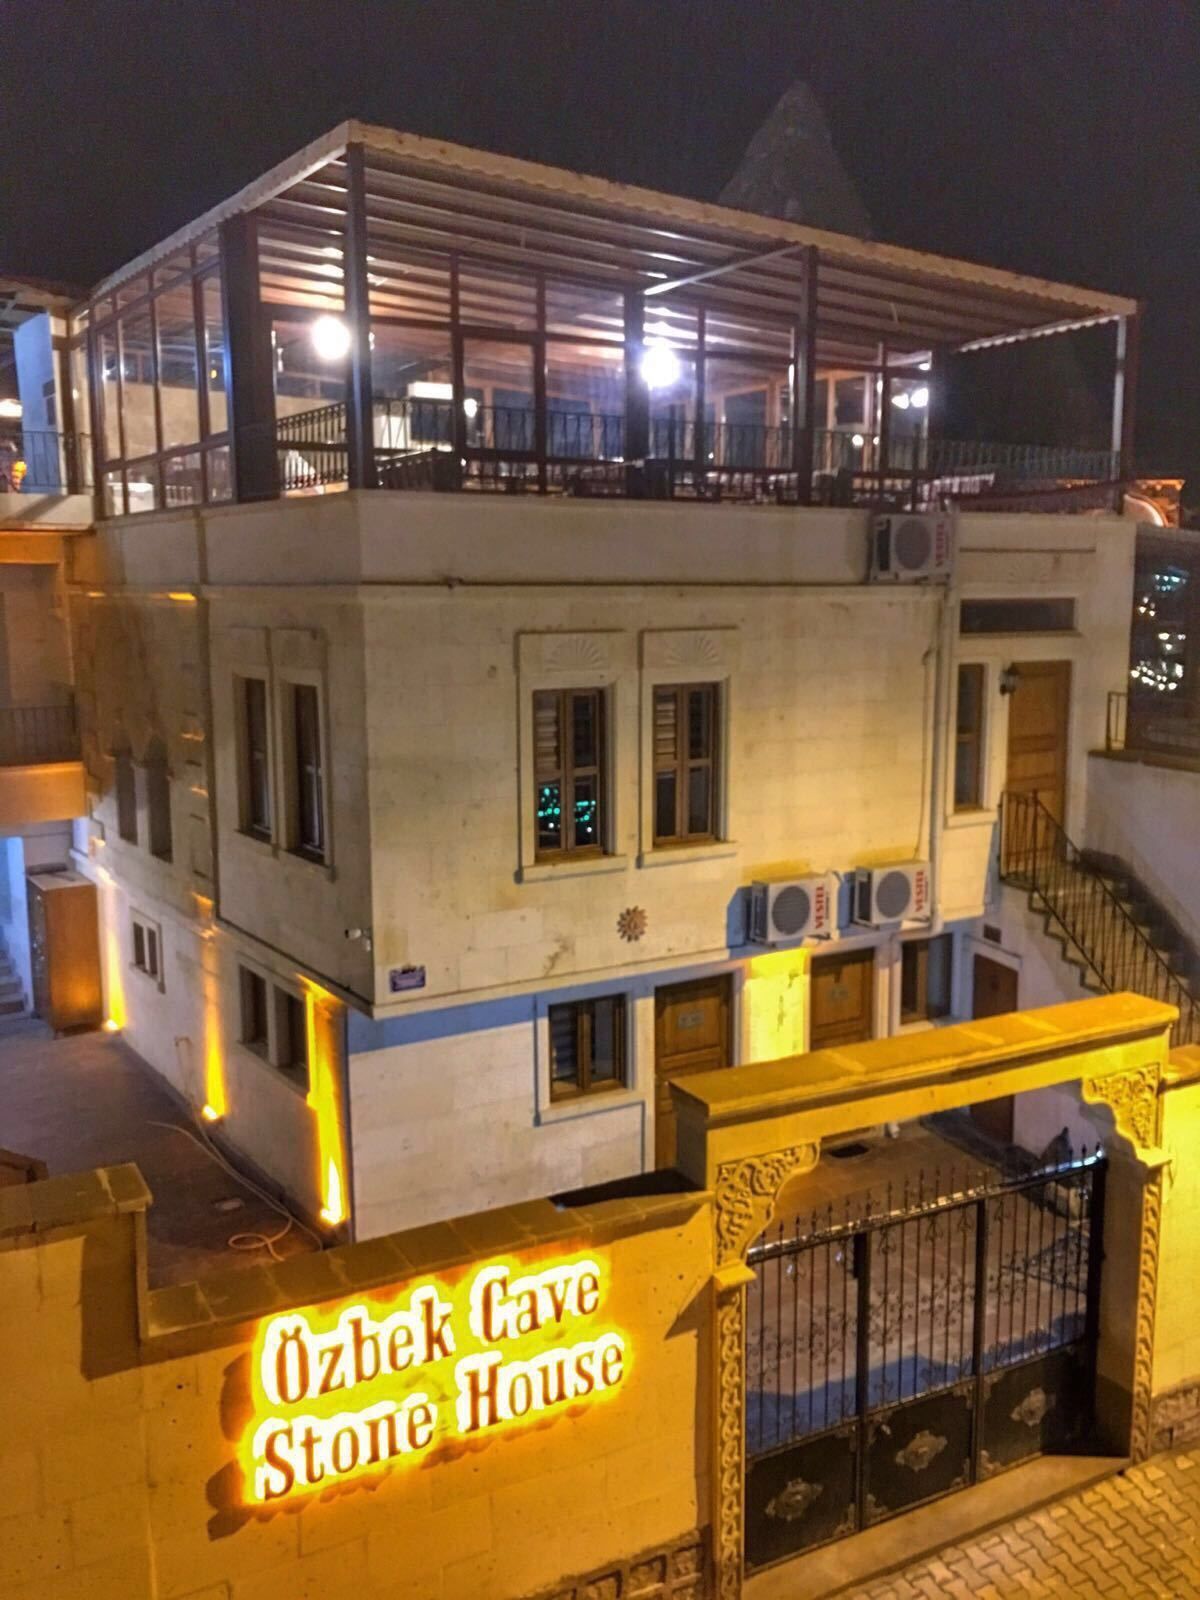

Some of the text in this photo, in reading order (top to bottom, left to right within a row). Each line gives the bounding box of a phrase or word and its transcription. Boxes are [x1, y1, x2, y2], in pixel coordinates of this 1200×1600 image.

[275, 1270, 599, 1405] Özbek Cave
[264, 1344, 624, 1500] Stone House
